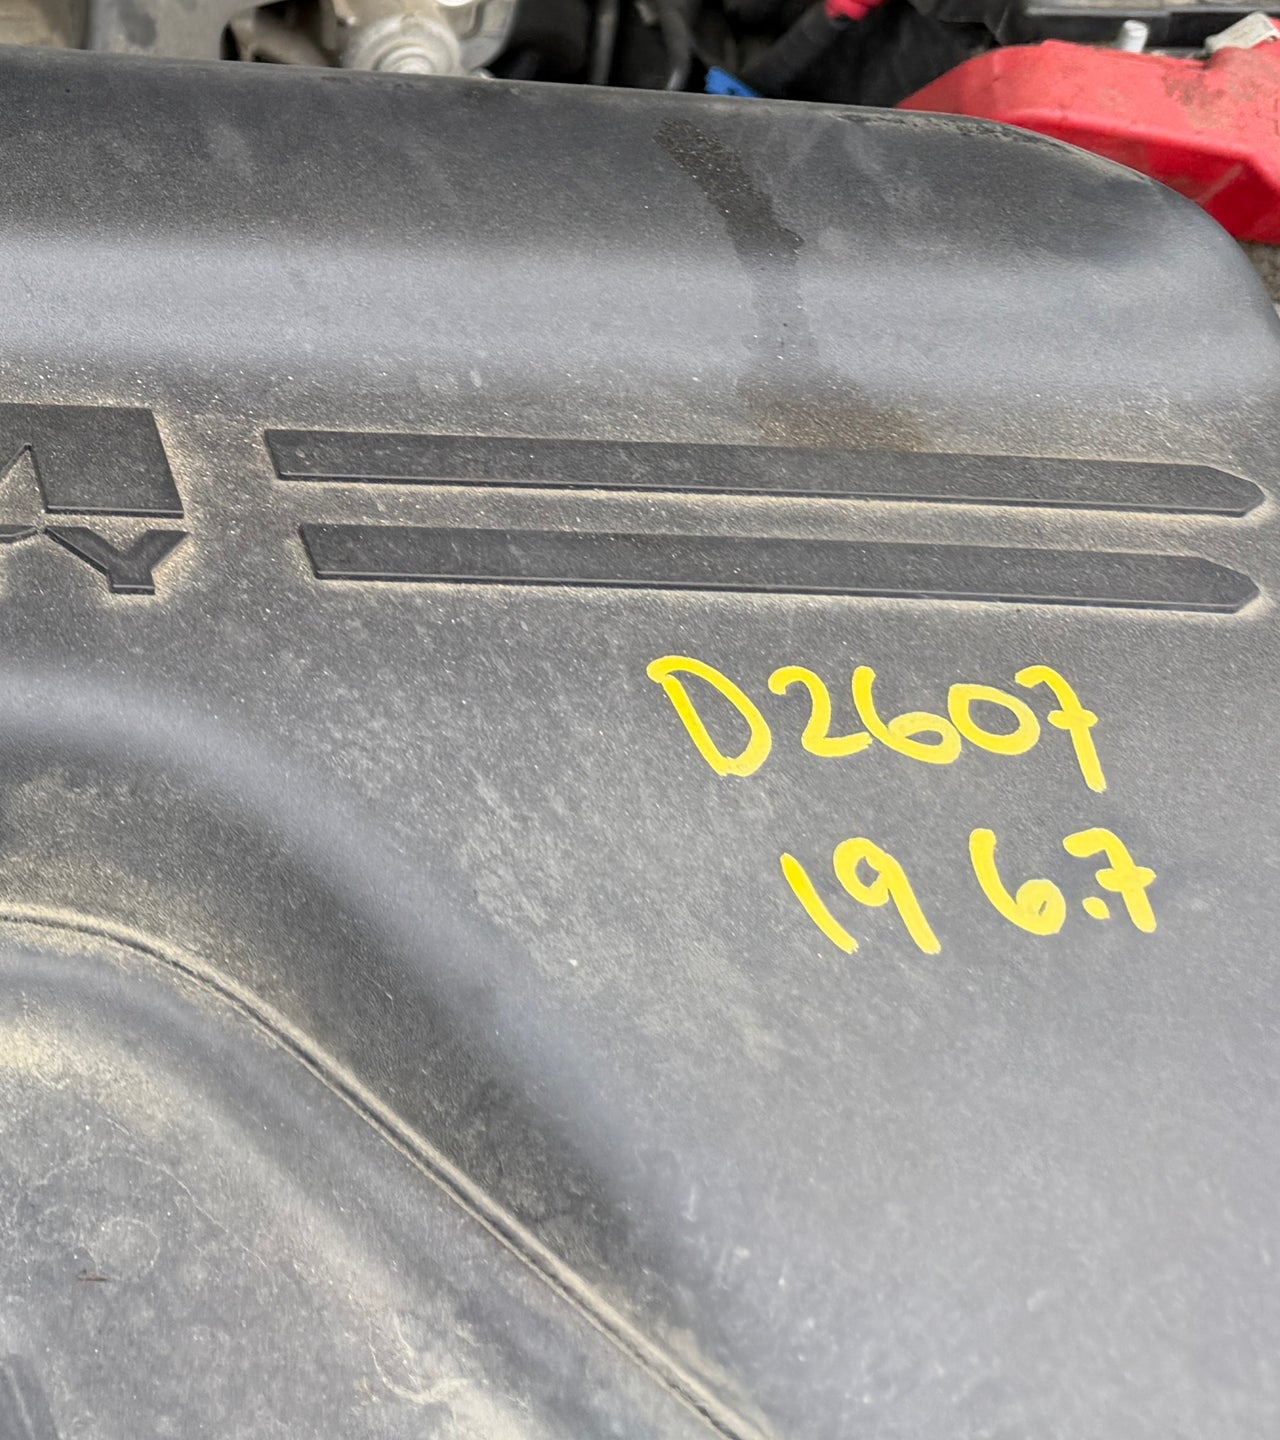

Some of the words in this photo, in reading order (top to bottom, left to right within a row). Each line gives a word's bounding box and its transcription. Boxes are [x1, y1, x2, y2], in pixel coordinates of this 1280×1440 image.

[646, 655, 1107, 792] D2607
[781, 836, 941, 954] 19
[969, 827, 1157, 934] 6.7
